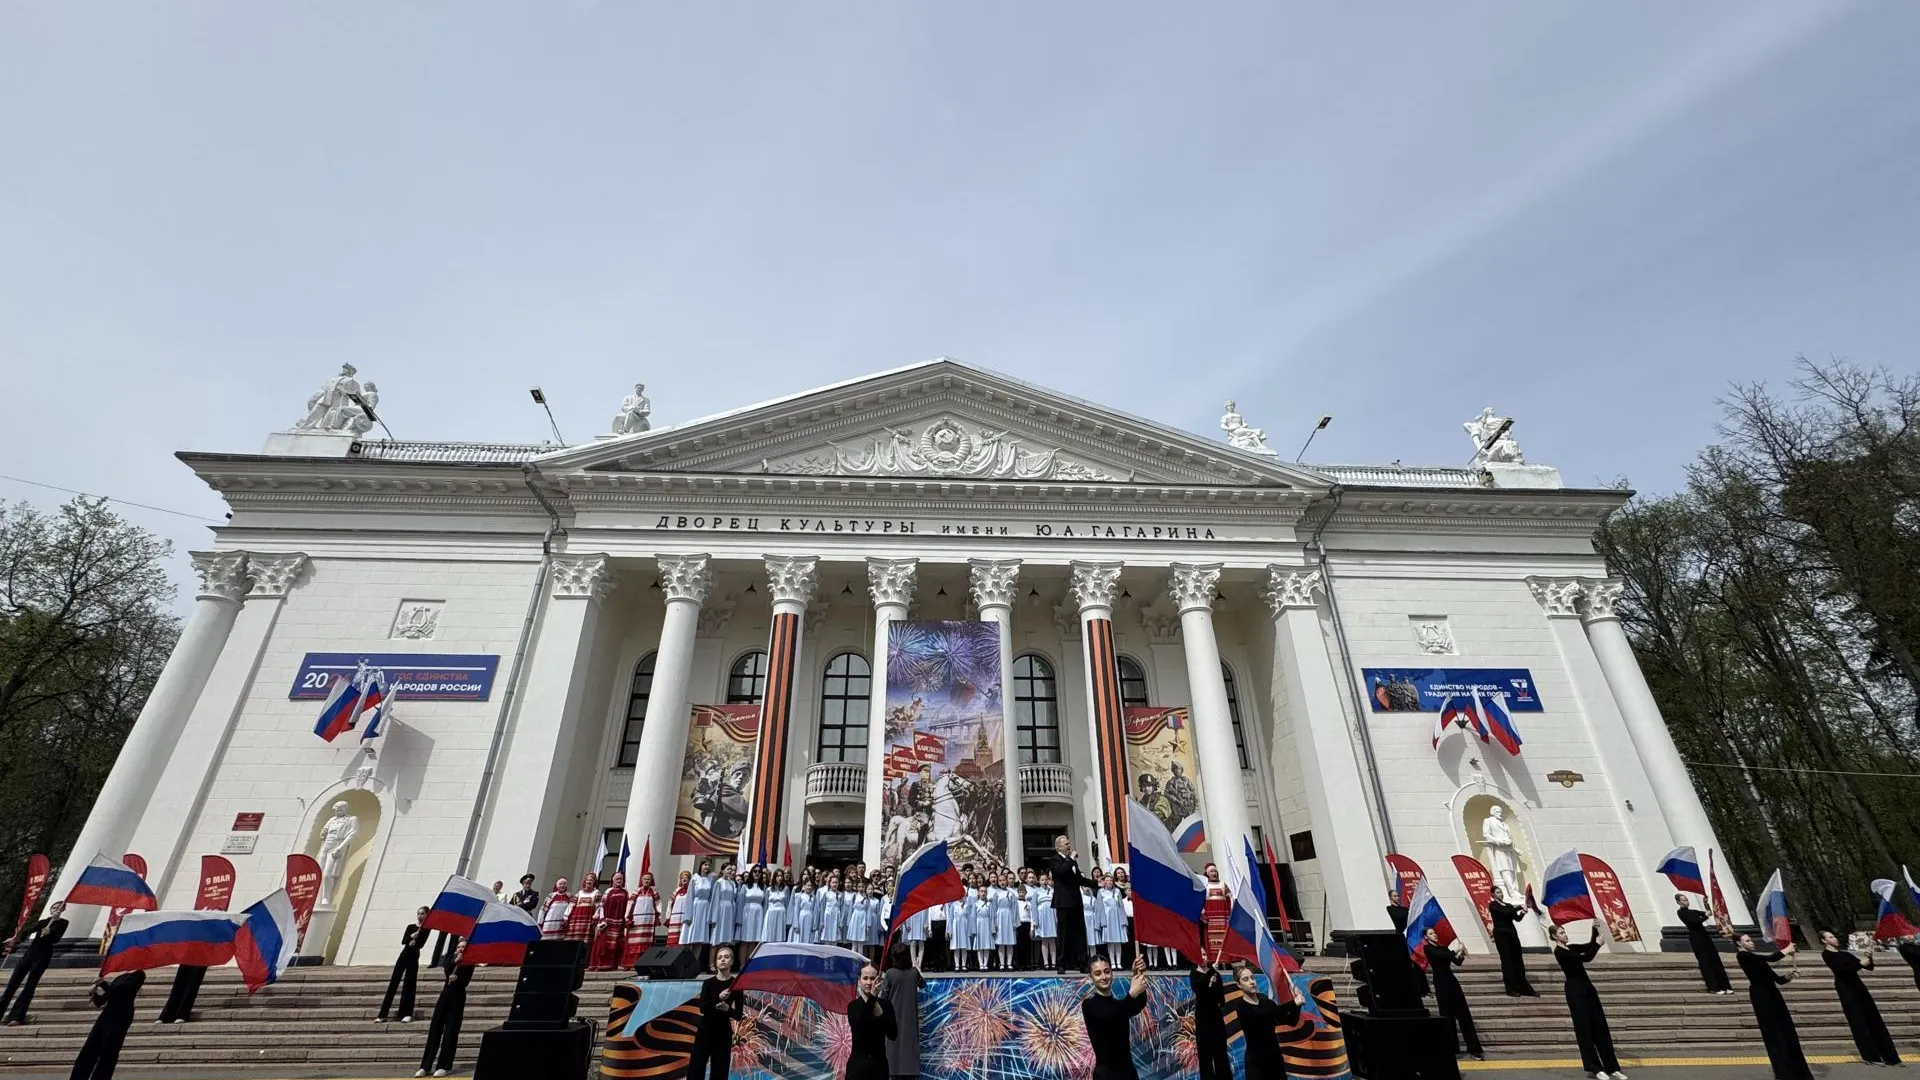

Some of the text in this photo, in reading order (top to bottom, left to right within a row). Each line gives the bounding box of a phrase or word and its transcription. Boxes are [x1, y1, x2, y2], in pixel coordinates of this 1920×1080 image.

[656, 516, 759, 530] ДВОРЕЦ
[780, 519, 914, 533] КУЛЬТУРЫ
[942, 525, 1008, 535] ИМЕНИ
[1091, 526, 1215, 539] ГАГАРИНА
[415, 672, 469, 682] ЕДИНСТВА
[439, 684, 482, 692] РОССИИ
[205, 874, 231, 885] 9 МАЯ
[292, 873, 317, 885] 9 МАЯ
